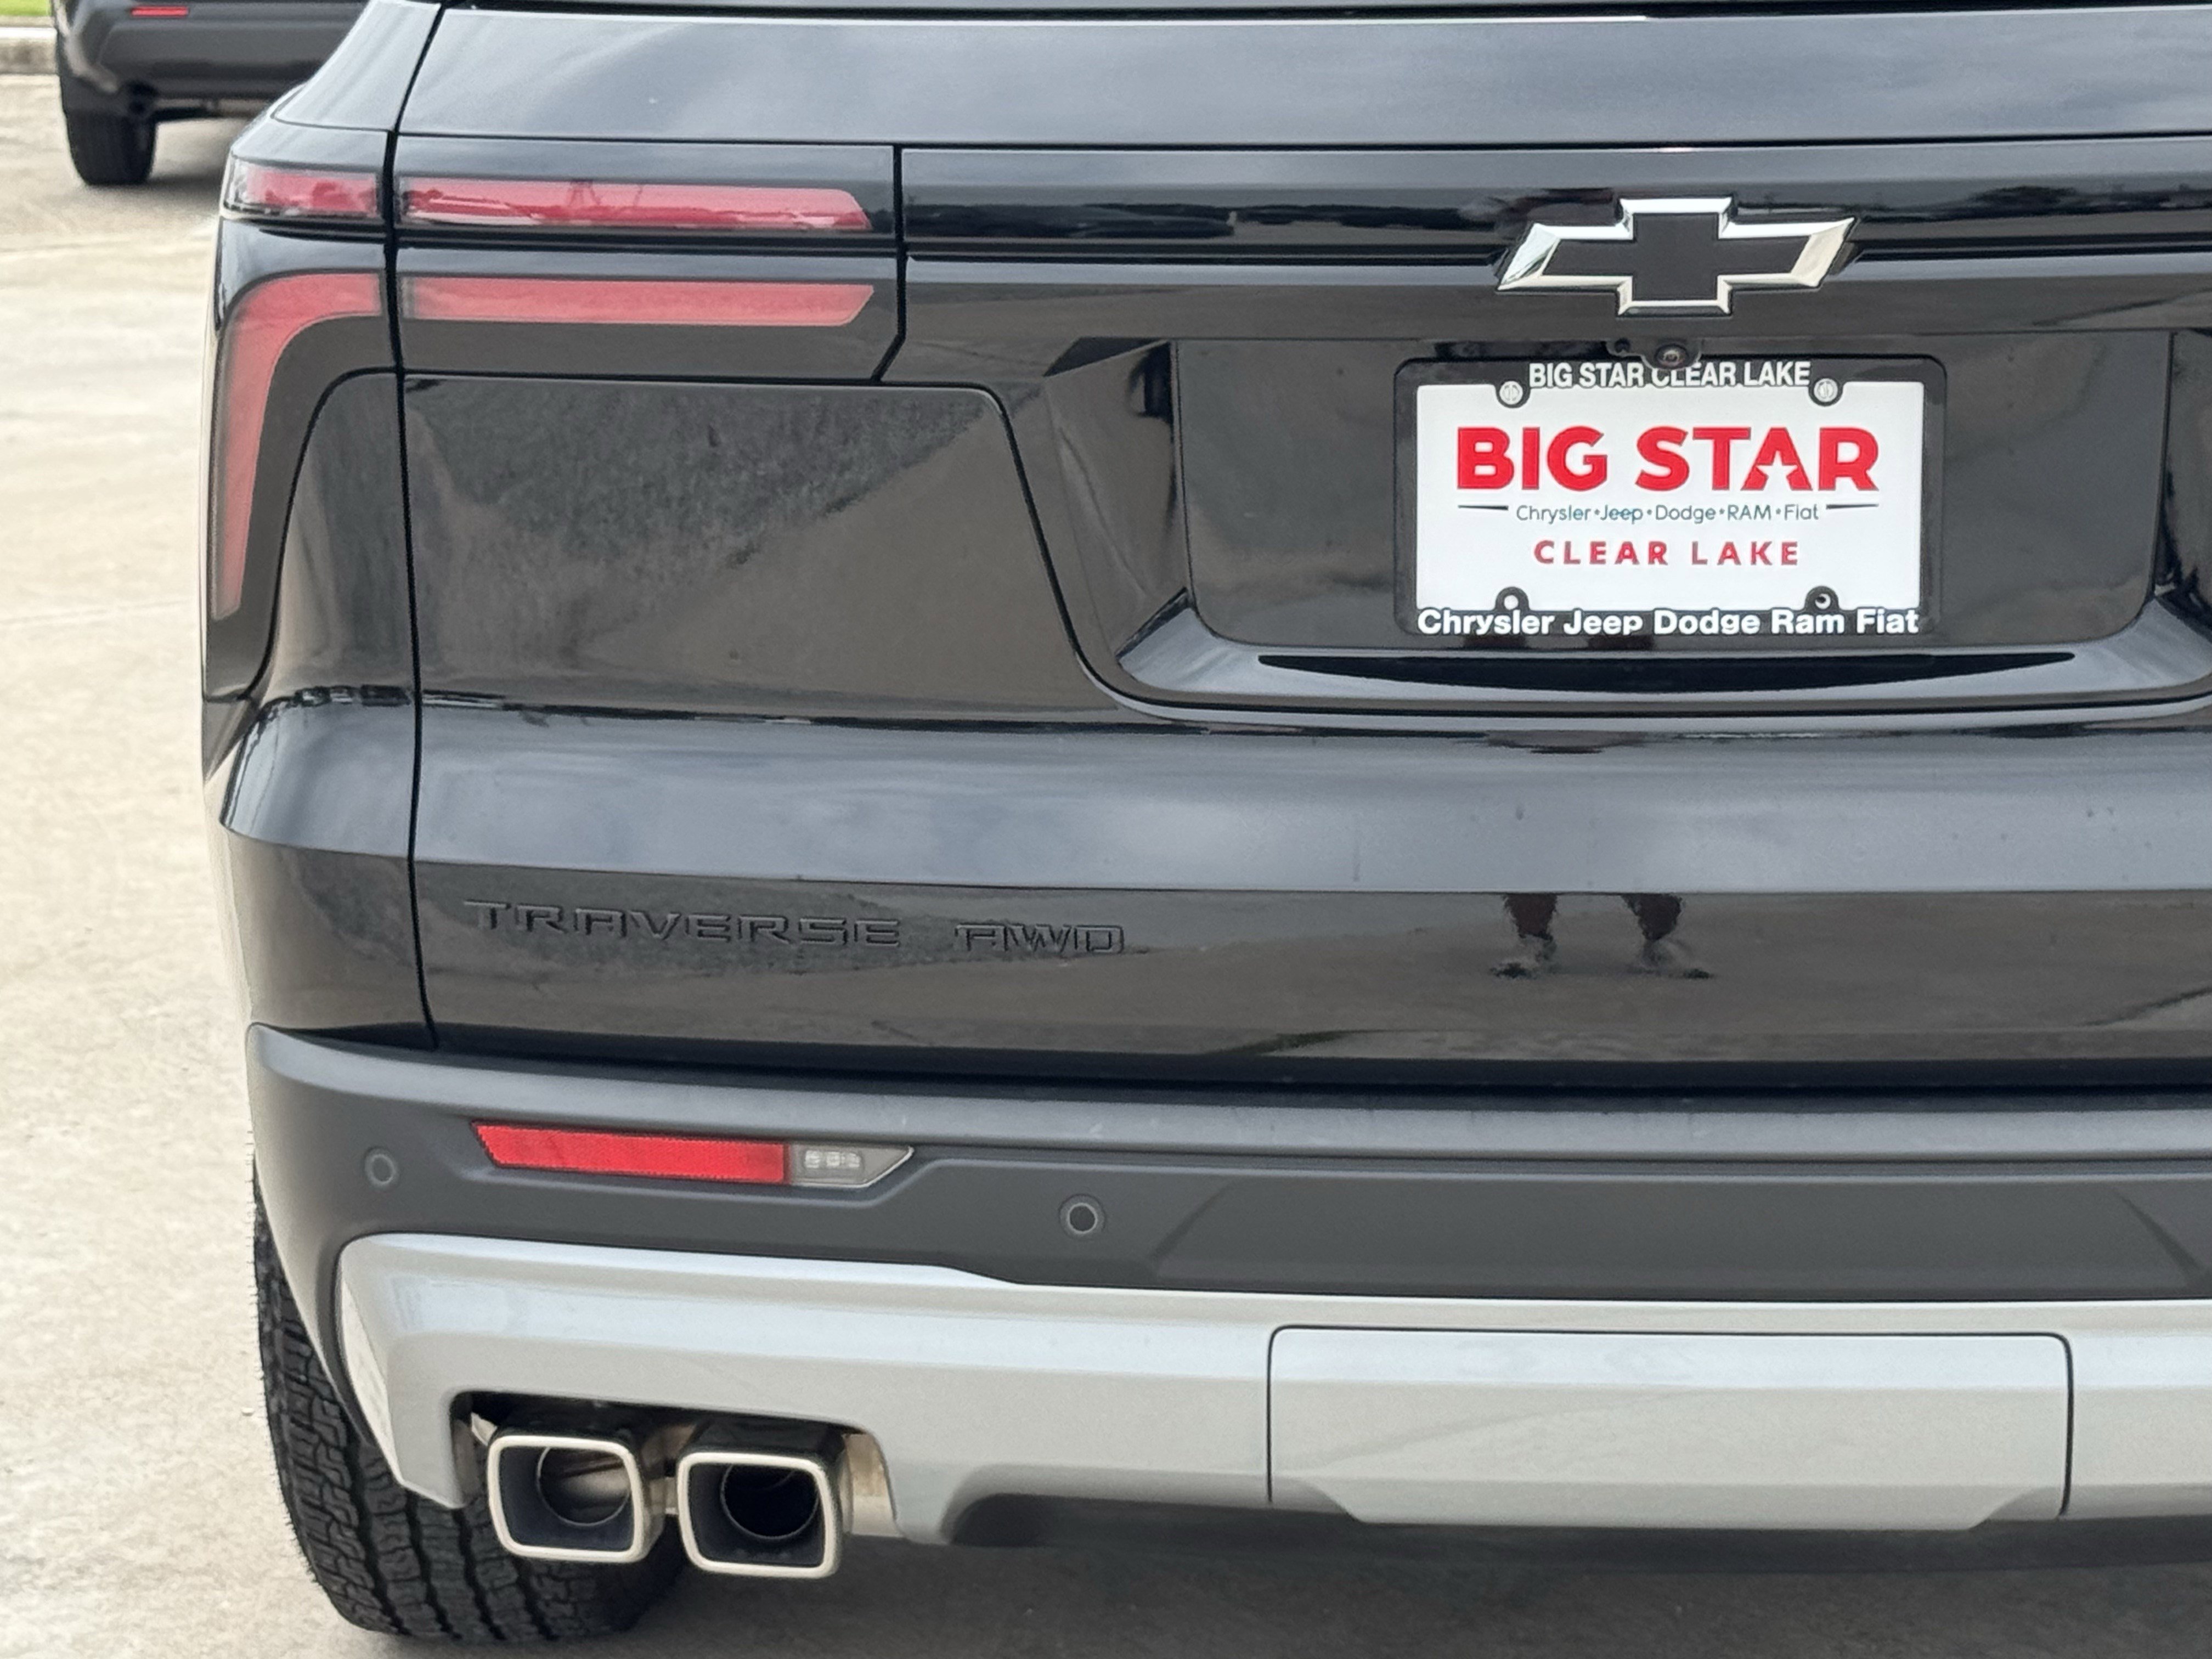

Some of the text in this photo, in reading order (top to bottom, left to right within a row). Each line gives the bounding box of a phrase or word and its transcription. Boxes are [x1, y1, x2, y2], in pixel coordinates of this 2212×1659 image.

[1529, 362, 1810, 387] BIG STAR CLEAR LAKE
[1457, 426, 1880, 492] BIG STAR
[1533, 540, 1798, 566] CLEAR LAKE
[1417, 607, 1920, 636] Chrysler Jeep Dodge Ram Fiat
[464, 898, 1125, 954] TRAVERSE AWD
